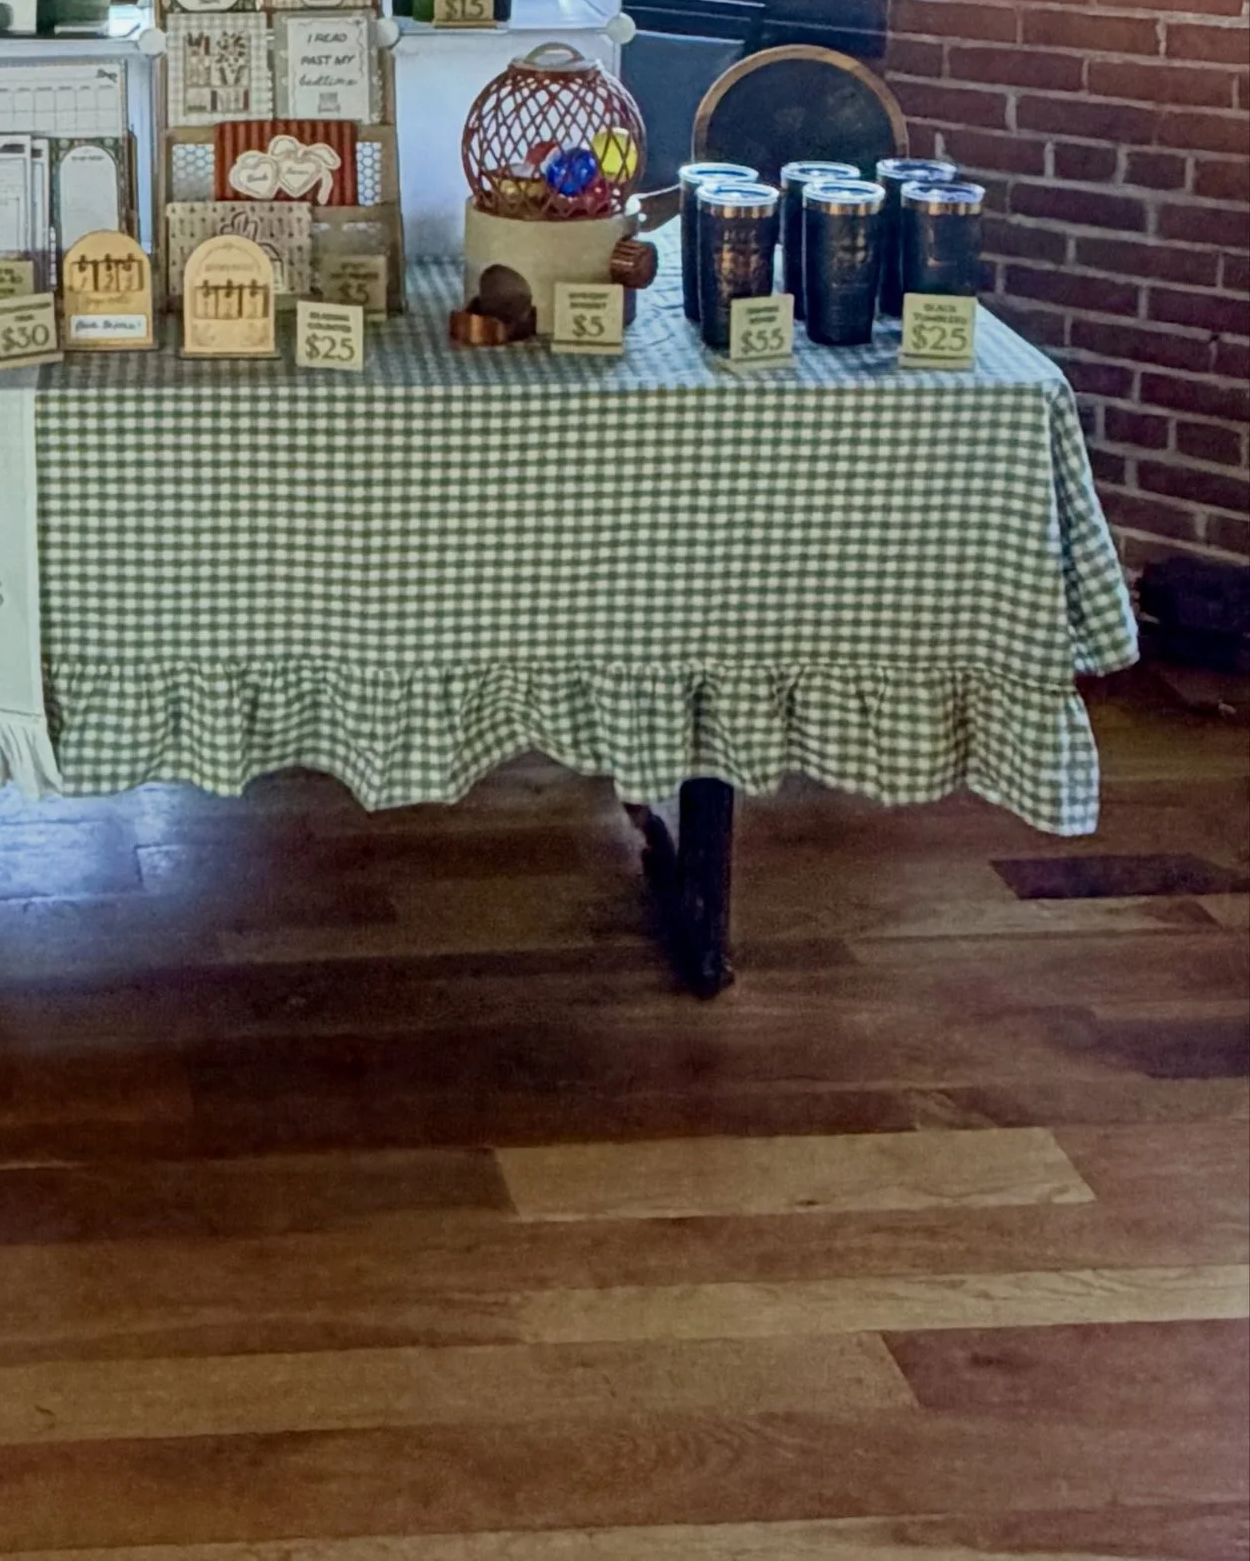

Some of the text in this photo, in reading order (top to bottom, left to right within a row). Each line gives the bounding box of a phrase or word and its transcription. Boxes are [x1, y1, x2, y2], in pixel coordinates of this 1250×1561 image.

[314, 32, 348, 43] READ
[300, 54, 332, 66] PAST
[2, 323, 49, 351] $30
[572, 313, 605, 338] $5
[911, 323, 968, 351] $25
[305, 332, 355, 362] $25
[741, 326, 785, 355] $55
